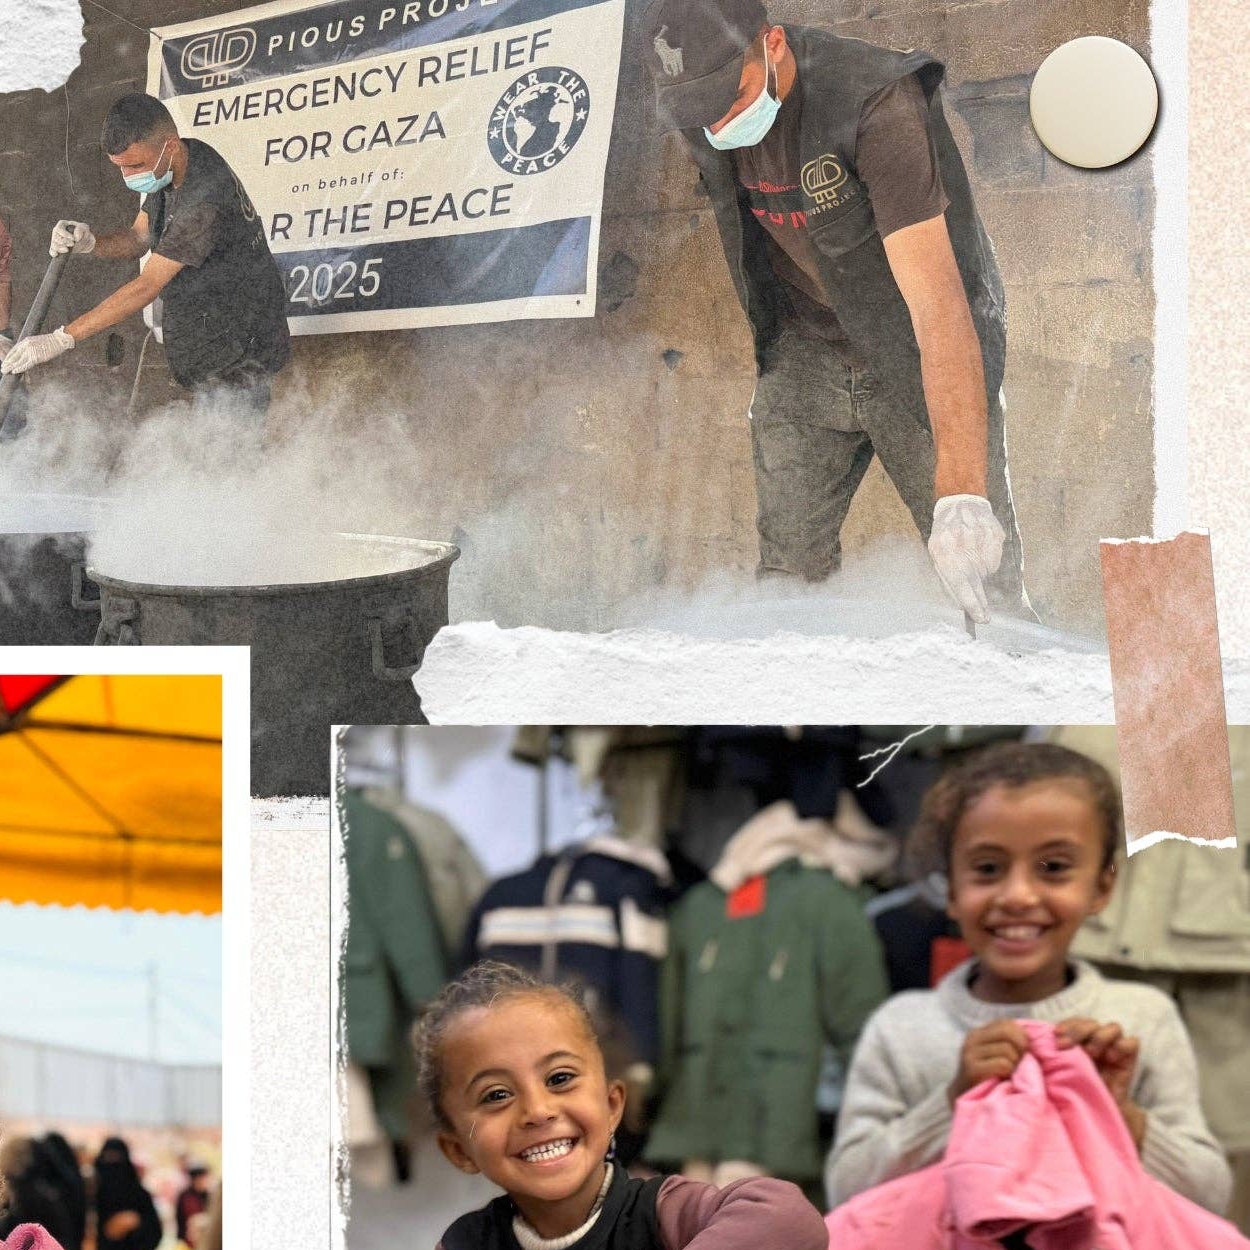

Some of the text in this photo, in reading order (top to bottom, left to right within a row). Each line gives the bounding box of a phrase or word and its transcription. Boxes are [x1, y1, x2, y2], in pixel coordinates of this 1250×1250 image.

[268, 15, 365, 56] PIOUS
[193, 28, 554, 127] EMERGENCY RELIEF
[492, 70, 587, 122] WEAR THE
[264, 111, 447, 166] FOR GAZA
[500, 139, 571, 175] PEACE
[291, 169, 405, 194] on behalf of:
[303, 202, 374, 240] THE
[382, 183, 515, 230] PEACE
[289, 258, 383, 303] 2025
